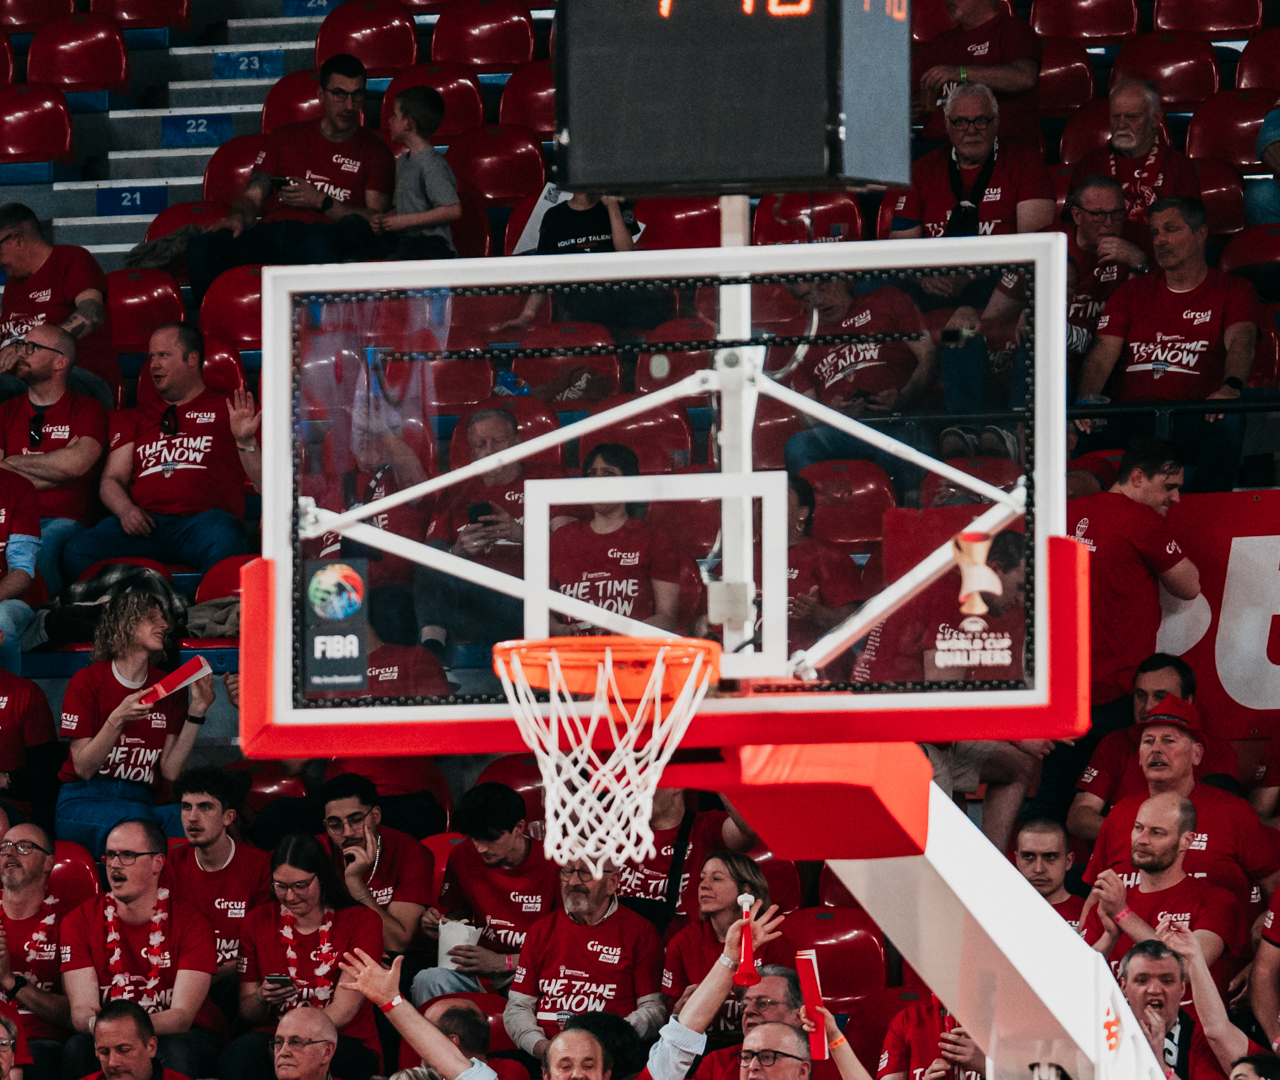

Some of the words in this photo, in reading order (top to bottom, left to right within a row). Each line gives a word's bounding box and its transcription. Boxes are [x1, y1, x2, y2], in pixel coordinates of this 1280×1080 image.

[238, 56, 260, 71] 23
[186, 118, 208, 133] 22
[121, 191, 142, 206] 21
[1183, 310, 1212, 320] Circus
[185, 411, 216, 420] Circus
[42, 424, 70, 433] Circus
[137, 440, 175, 464] THE
[178, 436, 212, 458] TIME
[143, 458, 164, 476] IS
[165, 449, 204, 467] NOW
[313, 633, 359, 659] FIBA
[510, 893, 541, 904] Circus
[587, 941, 621, 954] Circus
[557, 995, 605, 1014] NOW
